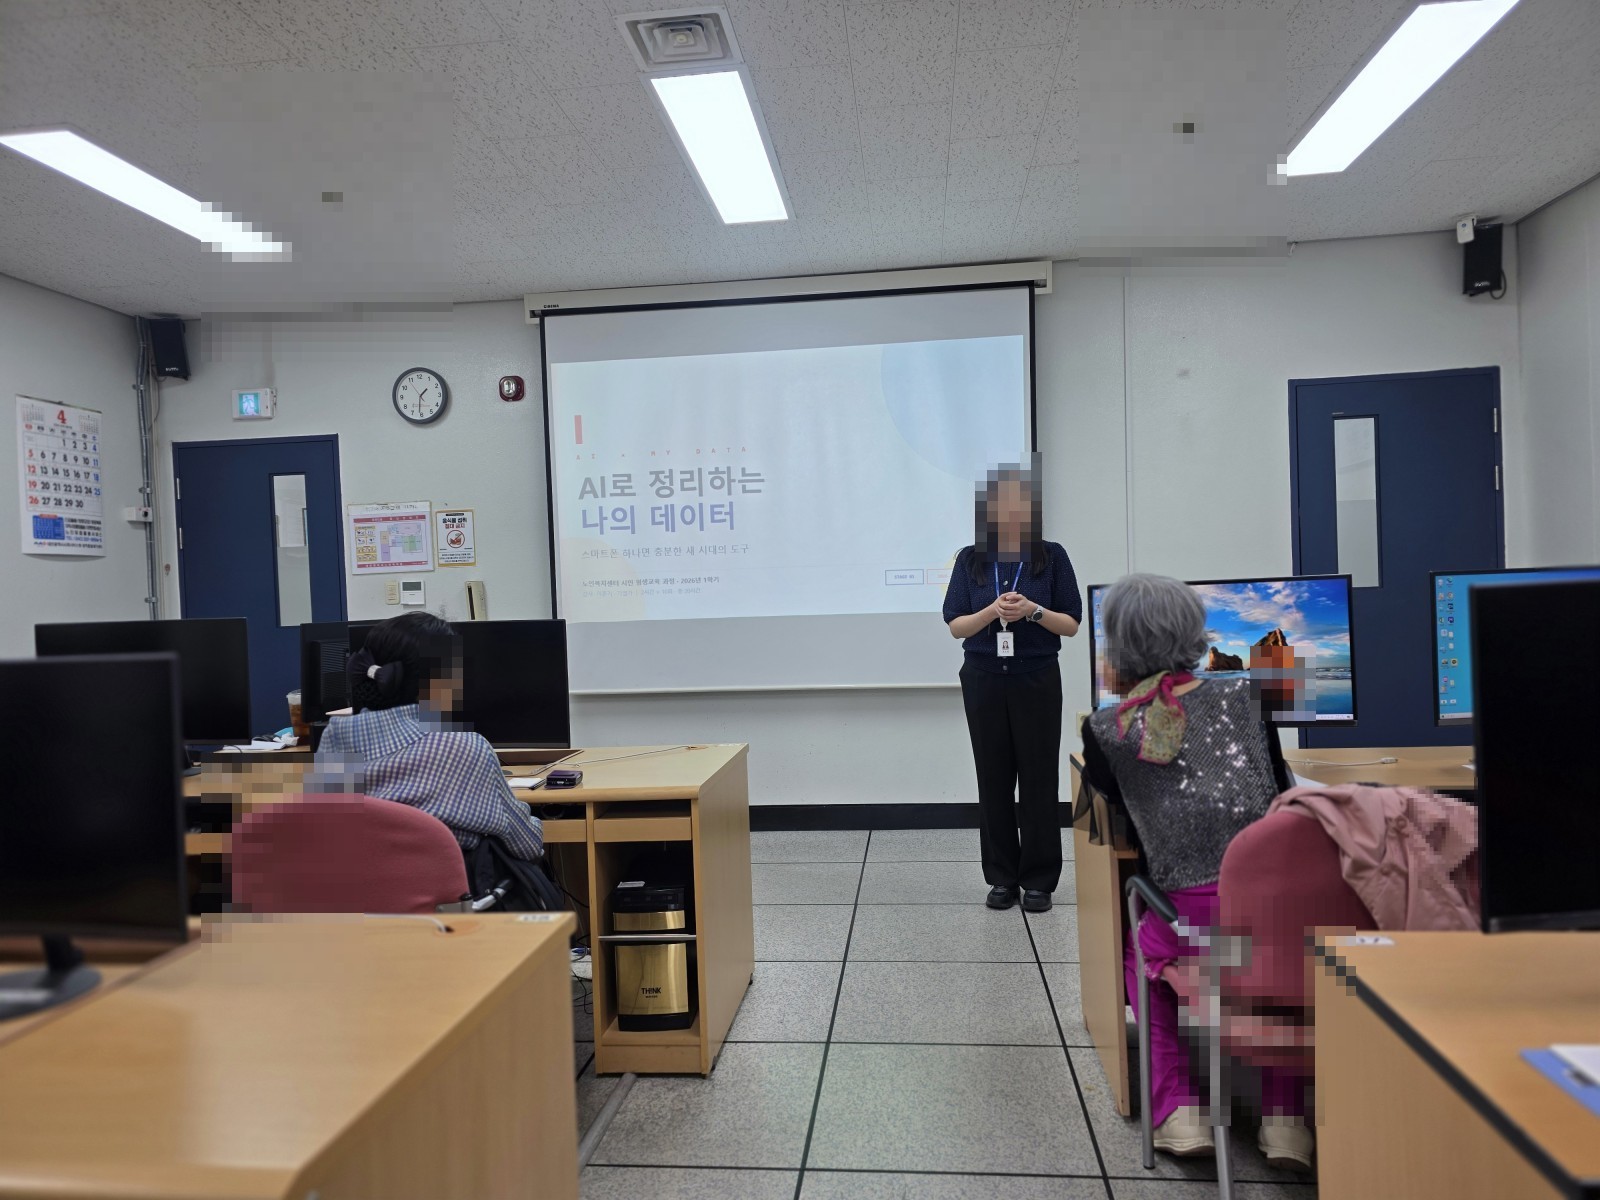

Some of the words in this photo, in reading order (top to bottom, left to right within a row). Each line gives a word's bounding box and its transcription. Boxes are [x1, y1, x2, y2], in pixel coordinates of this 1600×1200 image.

[57, 410, 66, 424] 4
[72, 441, 77, 449] 2
[83, 442, 87, 450] 3
[696, 446, 746, 455] DATA
[28, 449, 33, 458] 5
[41, 451, 45, 459] 6
[63, 454, 68, 462] 8
[74, 456, 78, 464] 9
[83, 457, 89, 465] 10
[28, 465, 36, 474] 12
[40, 466, 48, 475] 13
[52, 467, 59, 476] 14
[63, 469, 70, 477] 15
[74, 470, 81, 479] 16
[84, 472, 90, 480] 17
[28, 481, 37, 489] 19
[41, 481, 50, 490] 20
[52, 482, 61, 491] 21
[63, 484, 72, 493] 22
[74, 484, 82, 494] 23
[84, 486, 92, 495] 24
[94, 488, 101, 496] 25
[578, 473, 636, 500] AI로
[649, 466, 765, 498] 정리하는
[29, 496, 39, 504] 26
[41, 497, 50, 505] 27
[54, 498, 62, 506] 28
[65, 499, 73, 508] 29
[75, 500, 83, 508] 30
[582, 505, 636, 535] 나의
[651, 501, 734, 532] 데이터
[581, 549, 618, 559] 스마트폰
[622, 547, 650, 559] 하나면
[655, 546, 682, 557] 충분한
[686, 545, 695, 556] 새
[699, 544, 727, 556] 시대의
[731, 543, 750, 554] 도구
